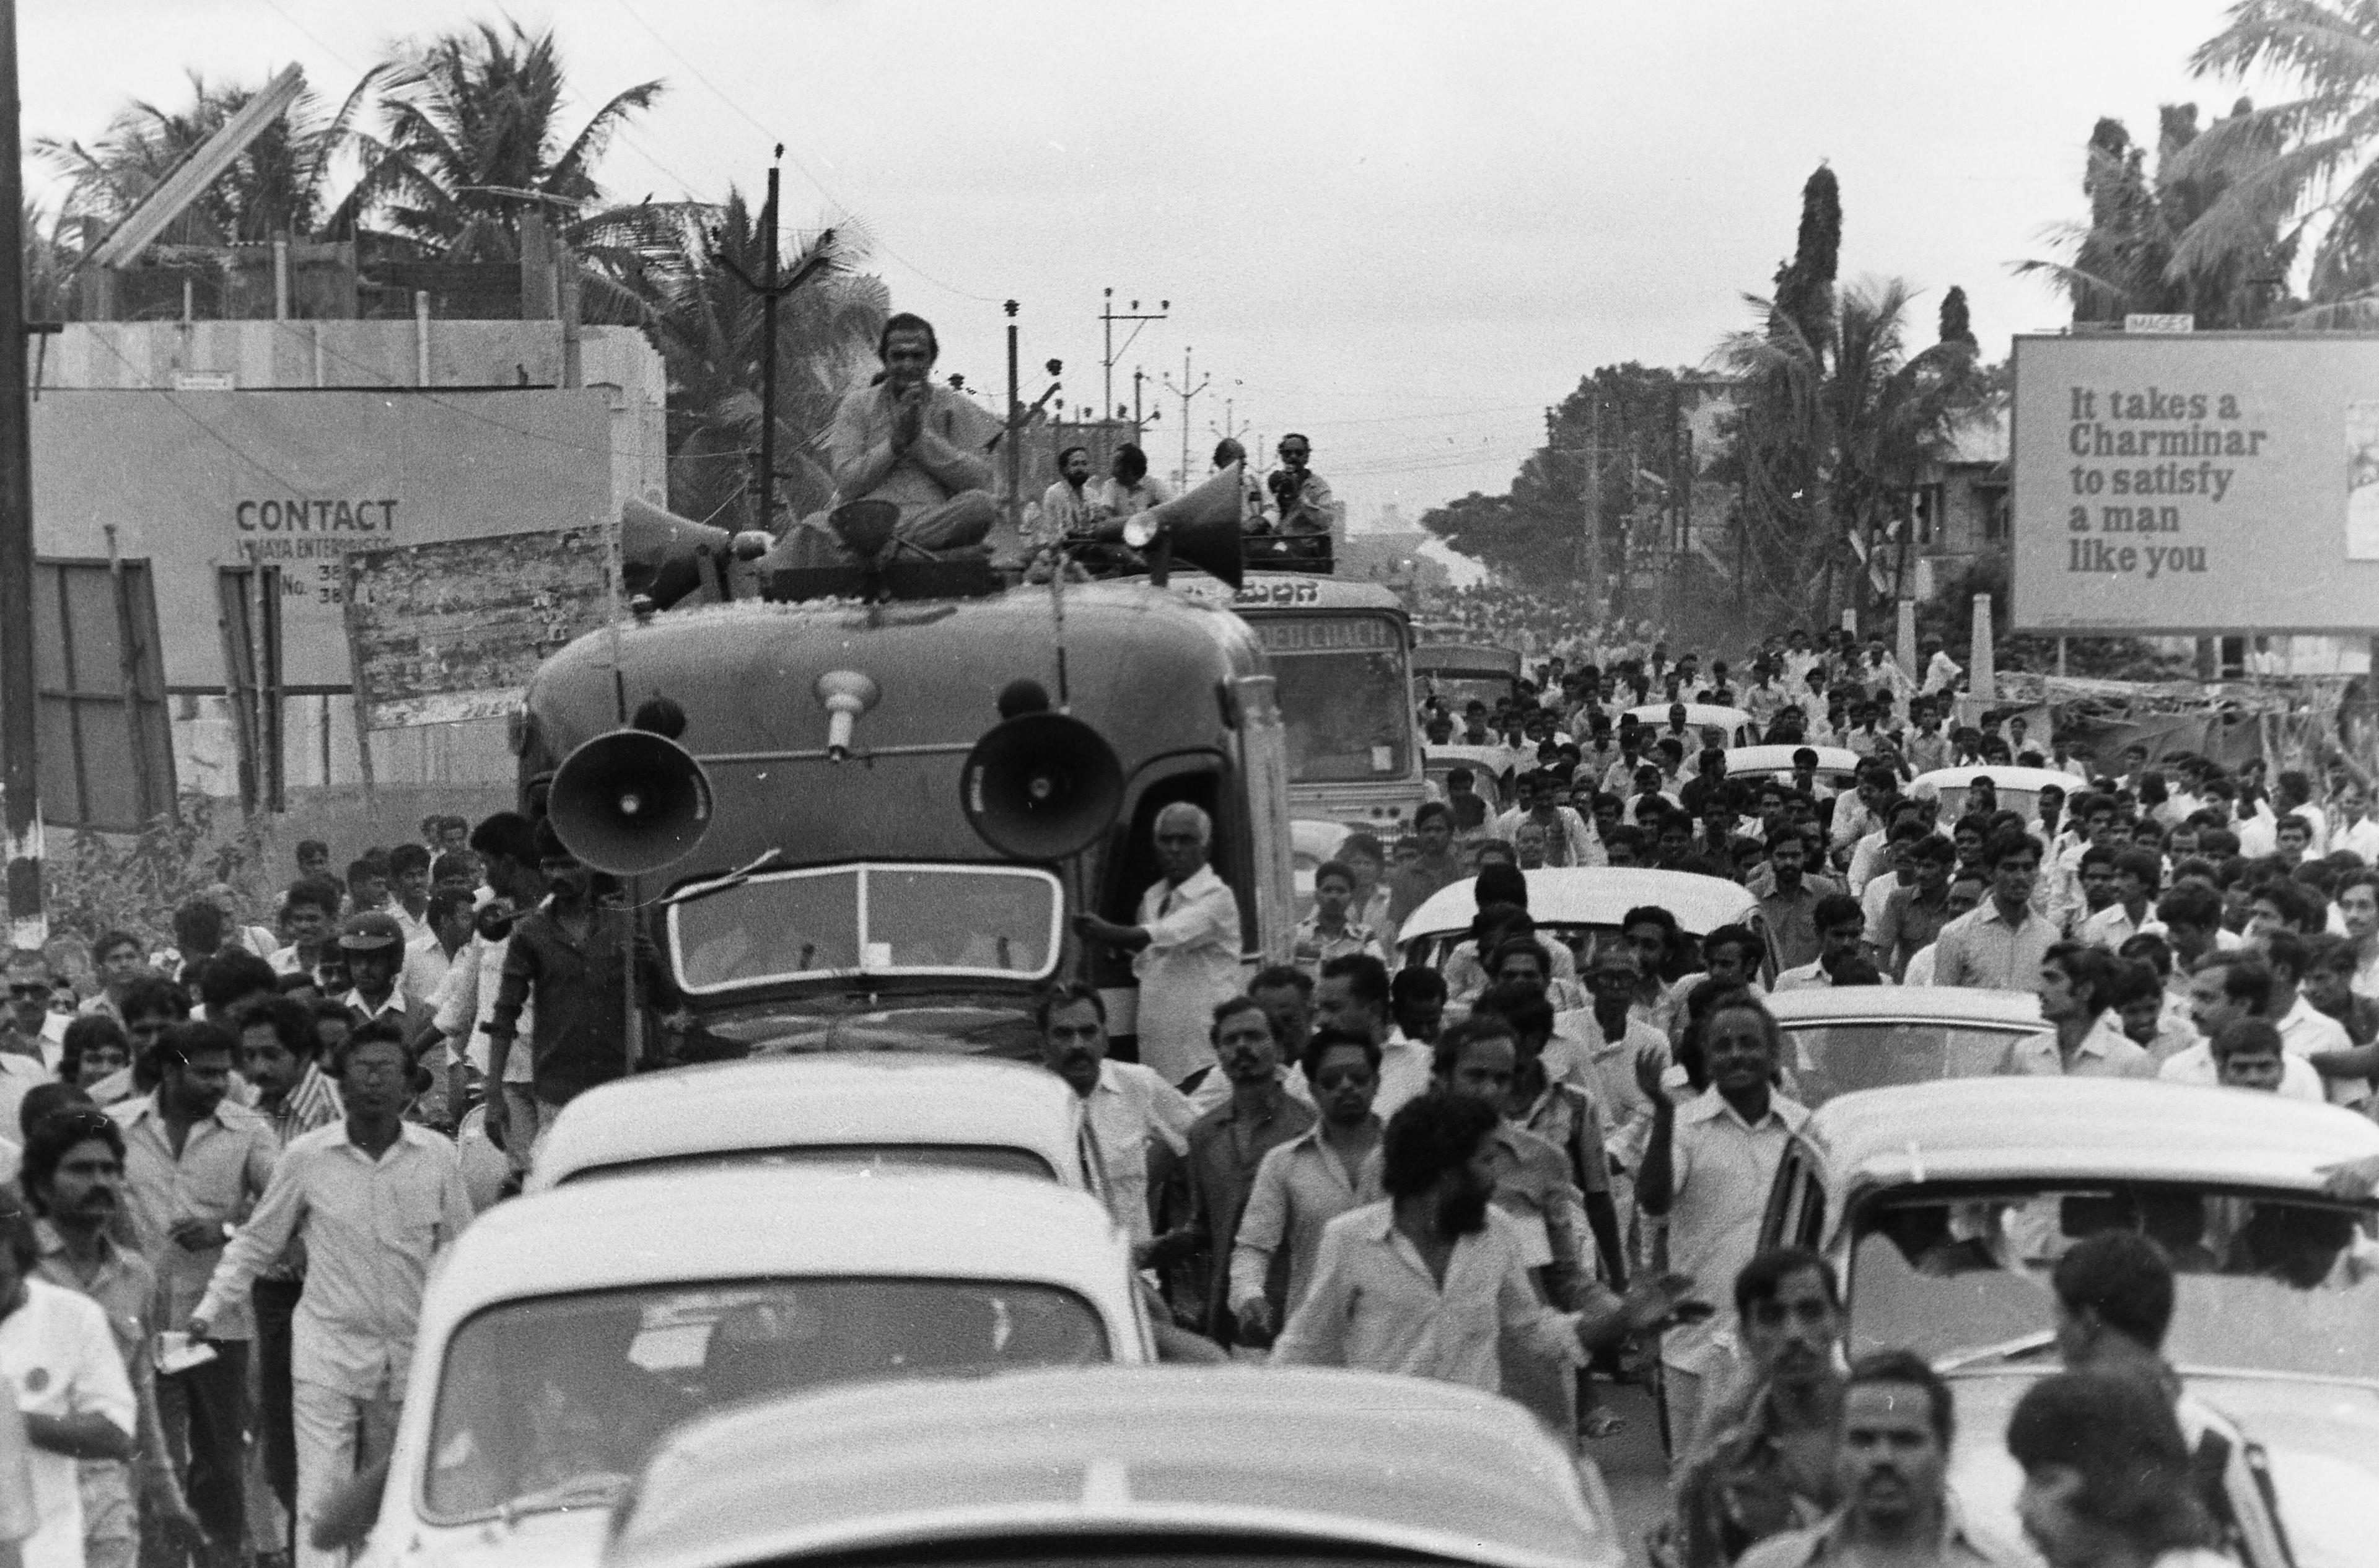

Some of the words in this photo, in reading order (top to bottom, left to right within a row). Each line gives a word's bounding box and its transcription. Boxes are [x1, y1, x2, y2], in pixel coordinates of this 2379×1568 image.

[2070, 387, 2096, 420] It
[2110, 387, 2207, 420] takes
[2218, 393, 2241, 420] a
[2070, 422, 2267, 456] Charminar
[2070, 465, 2104, 494] to
[2112, 462, 2234, 502] satisfy
[237, 499, 398, 530] CONTACT
[2069, 506, 2090, 532] a
[2103, 506, 2180, 532] man
[2068, 539, 2137, 572] like
[2145, 546, 2207, 579] you
